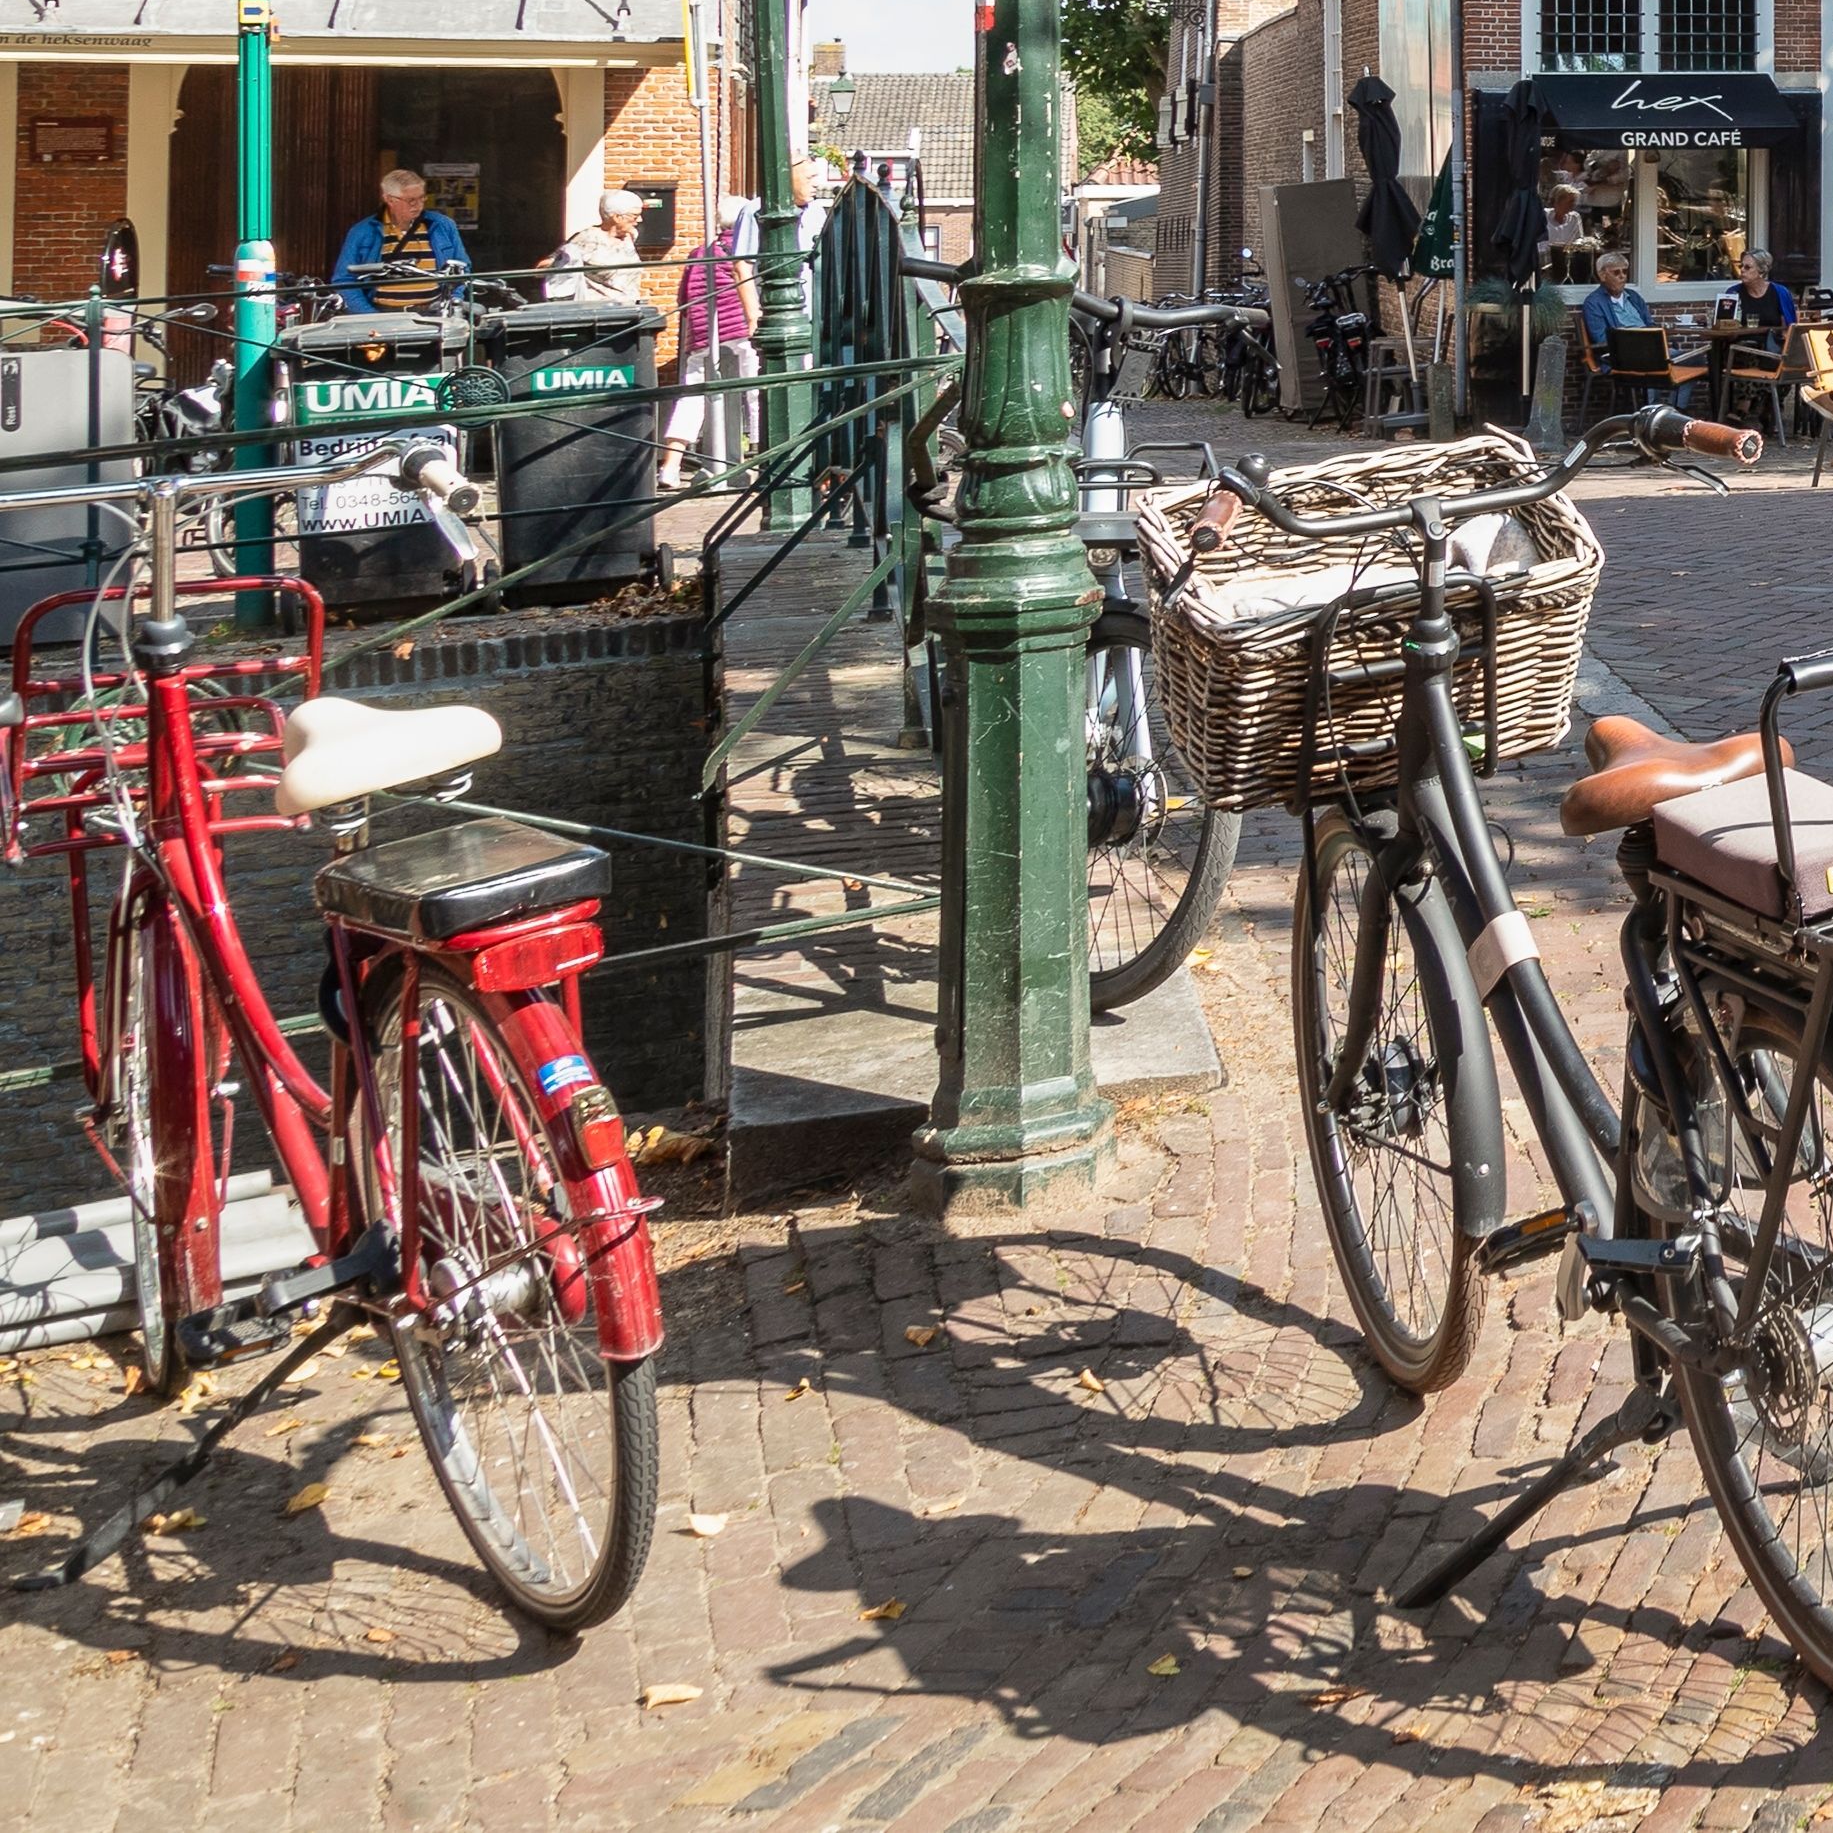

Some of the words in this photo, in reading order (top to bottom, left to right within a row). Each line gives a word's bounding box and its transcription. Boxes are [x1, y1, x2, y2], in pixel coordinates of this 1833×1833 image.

[15, 33, 36, 45] de
[42, 33, 152, 47] heksenwaag
[1611, 79, 1734, 121] hex
[1621, 131, 1688, 146] GRAND
[1694, 128, 1742, 145] CAFÉ
[536, 369, 629, 391] UMIA
[306, 379, 435, 413] UMIA
